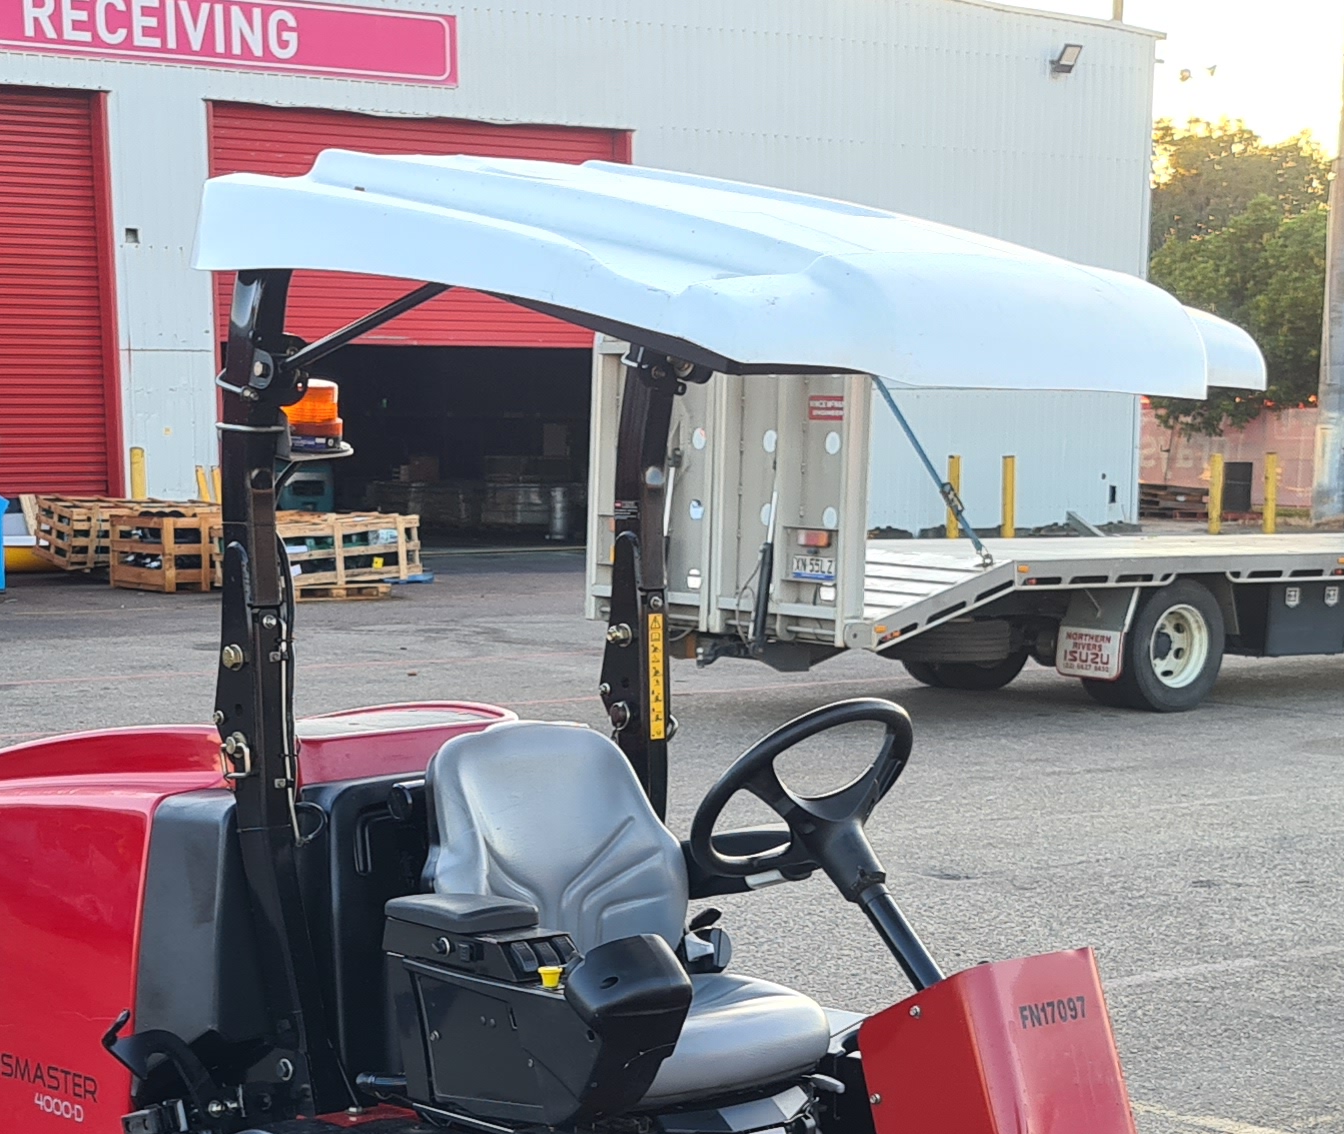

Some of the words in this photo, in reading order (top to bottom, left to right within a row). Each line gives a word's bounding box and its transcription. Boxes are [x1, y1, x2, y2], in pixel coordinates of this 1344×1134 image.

[22, 0, 298, 59] RECEIVING
[1066, 632, 1112, 644] NORTHERN
[1073, 642, 1102, 652] RIVERS
[1064, 650, 1109, 665] ISUZU
[1019, 995, 1085, 1029] FN17097
